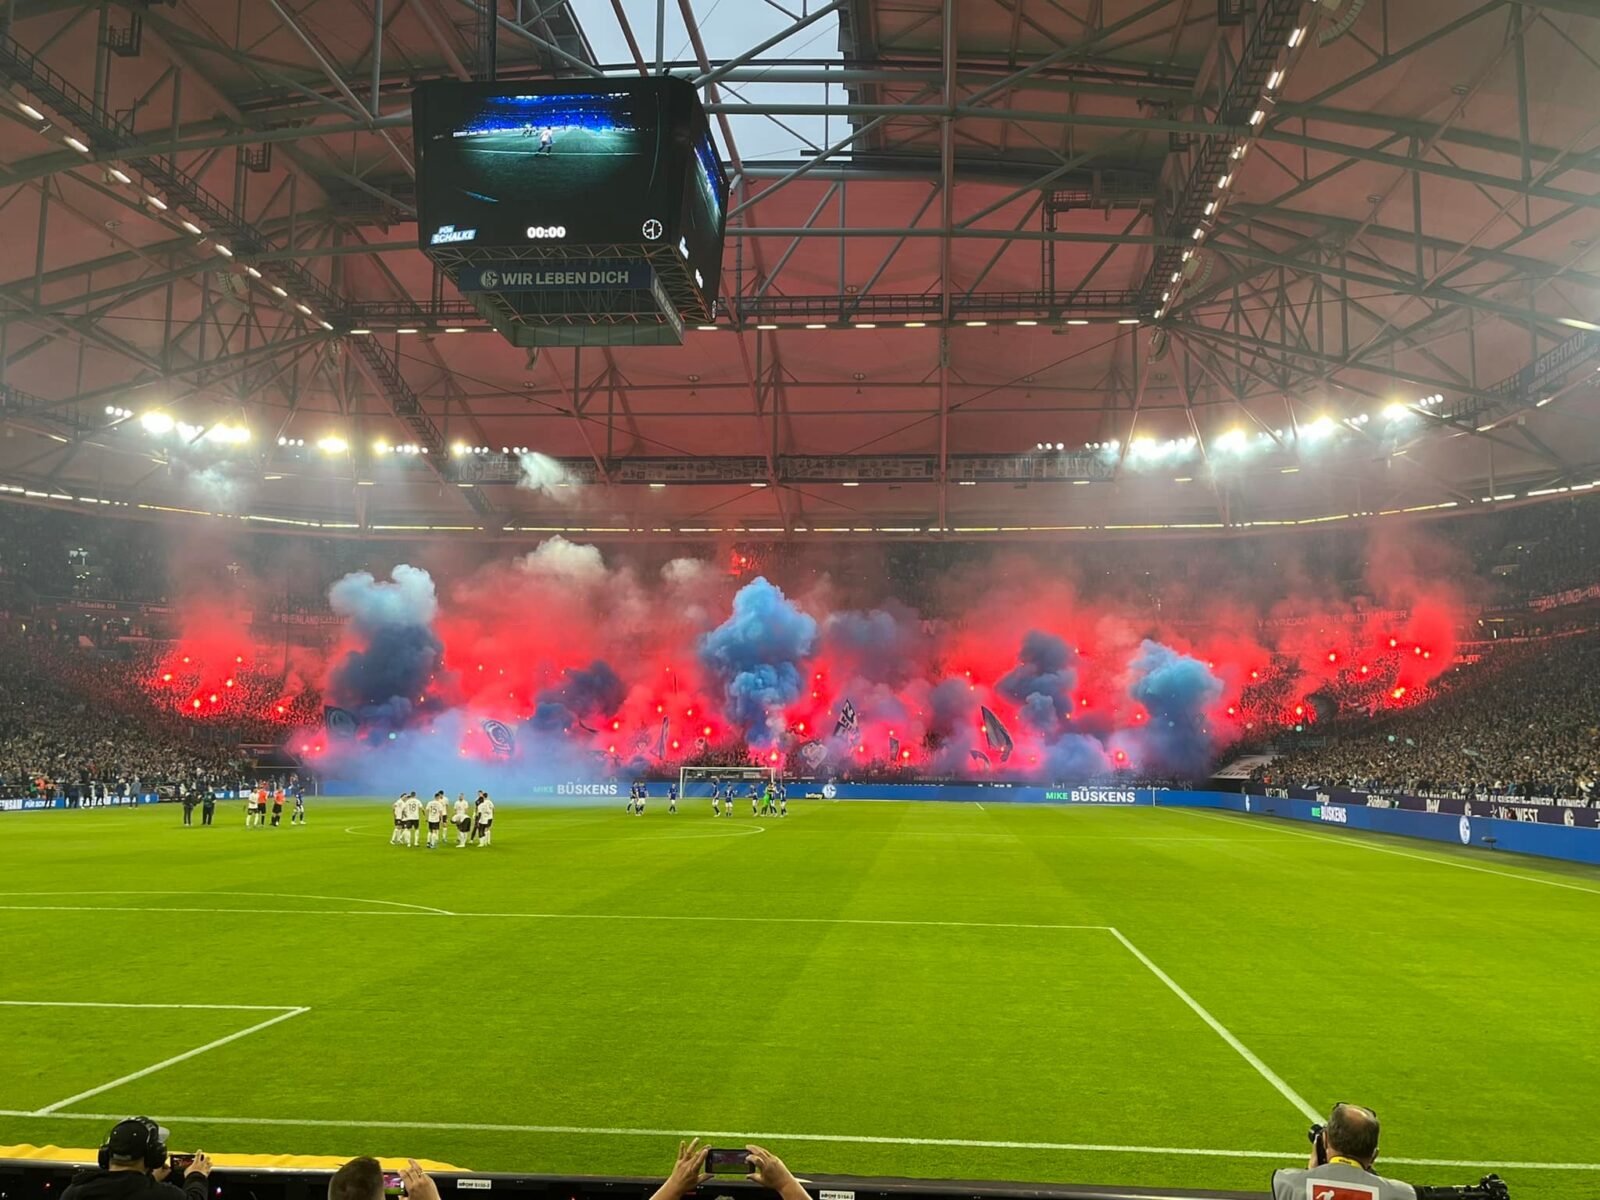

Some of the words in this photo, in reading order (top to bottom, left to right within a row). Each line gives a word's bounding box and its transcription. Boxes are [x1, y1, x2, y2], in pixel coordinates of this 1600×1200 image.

[431, 230, 476, 243] SCHALKE
[527, 226, 566, 238] 00:00
[502, 273, 533, 285] WIR
[536, 272, 587, 285] LEBEN
[589, 271, 629, 284] DICH
[557, 782, 617, 795] BÜSKENS
[1046, 792, 1068, 800] MIKE
[1071, 788, 1136, 803] BÜSKENS
[409, 803, 416, 812] 18
[430, 805, 437, 814] 15
